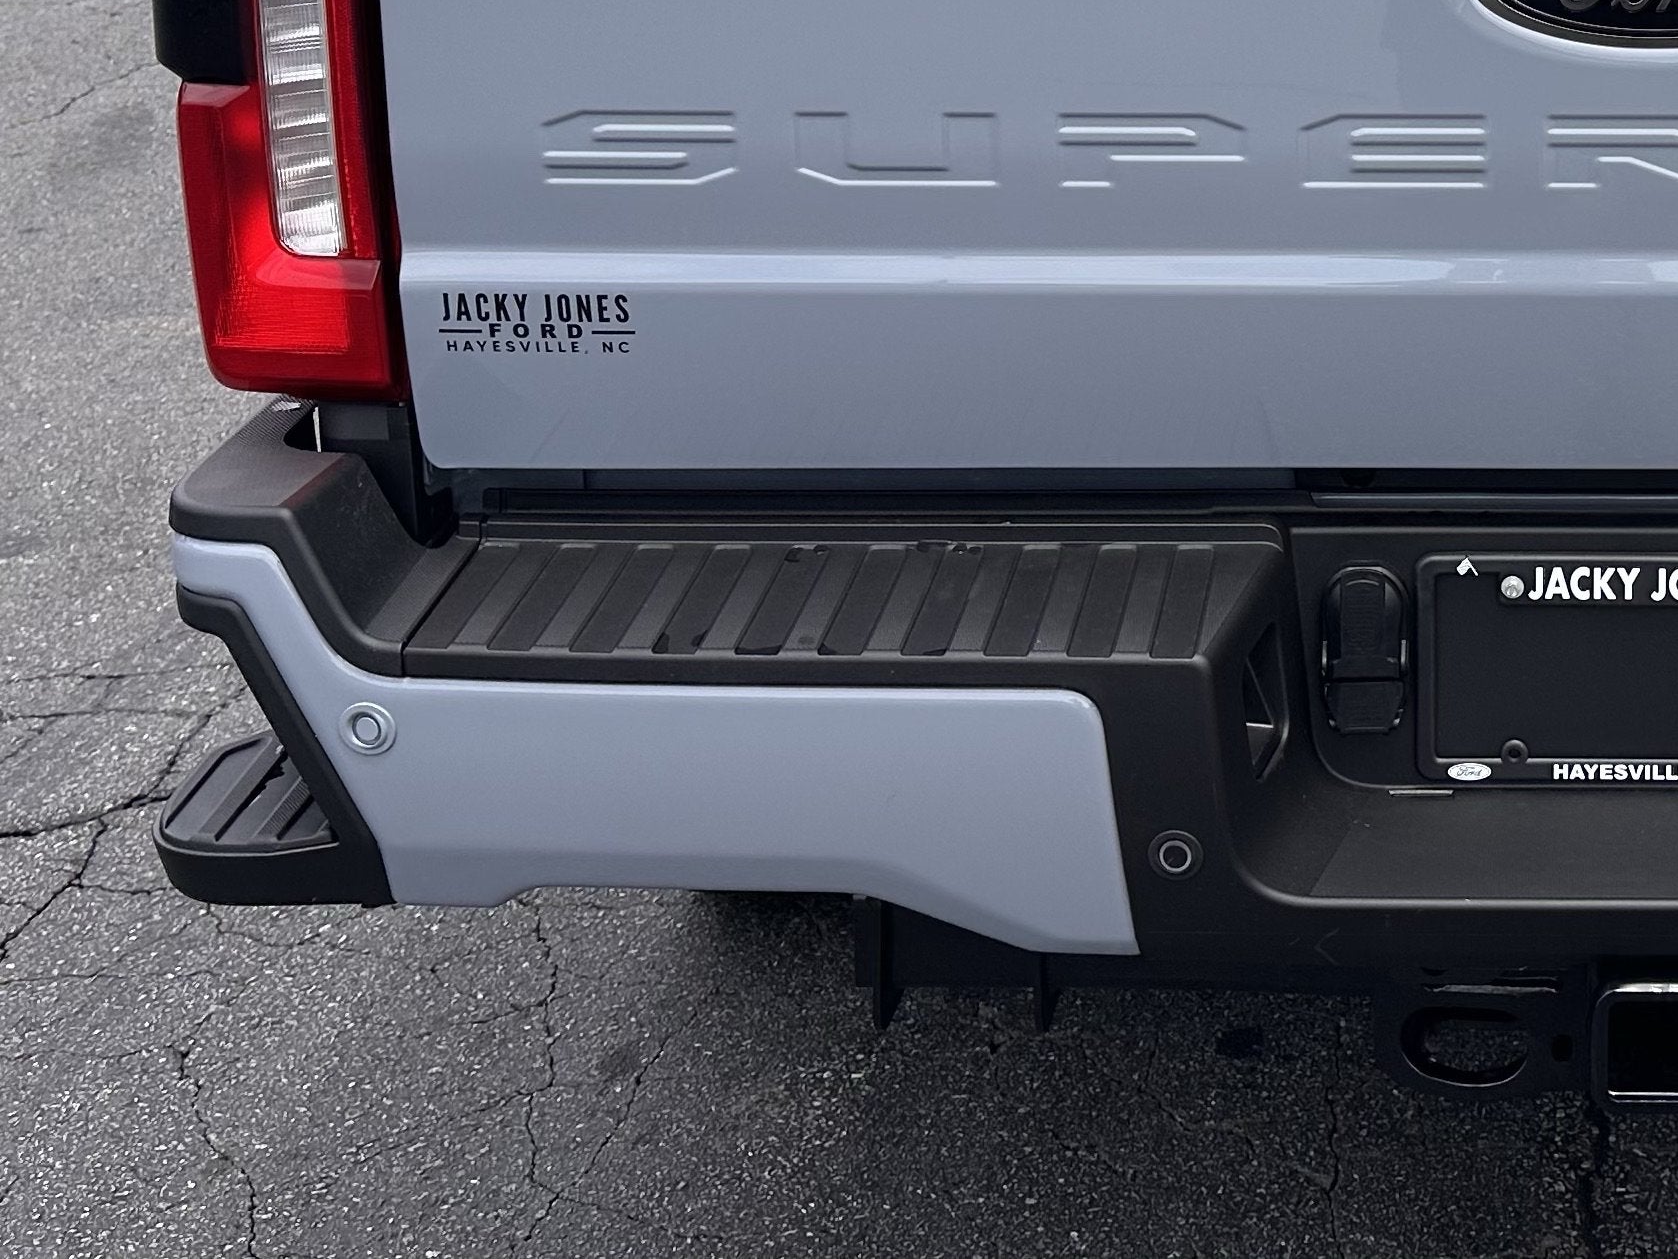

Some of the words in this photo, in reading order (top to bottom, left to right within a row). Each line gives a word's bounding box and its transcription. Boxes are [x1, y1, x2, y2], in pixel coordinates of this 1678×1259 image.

[441, 292, 528, 322] JACKY
[543, 293, 630, 324] JONES
[488, 323, 584, 339] FORD
[602, 341, 631, 354] NC
[1527, 566, 1641, 601] JACKY
